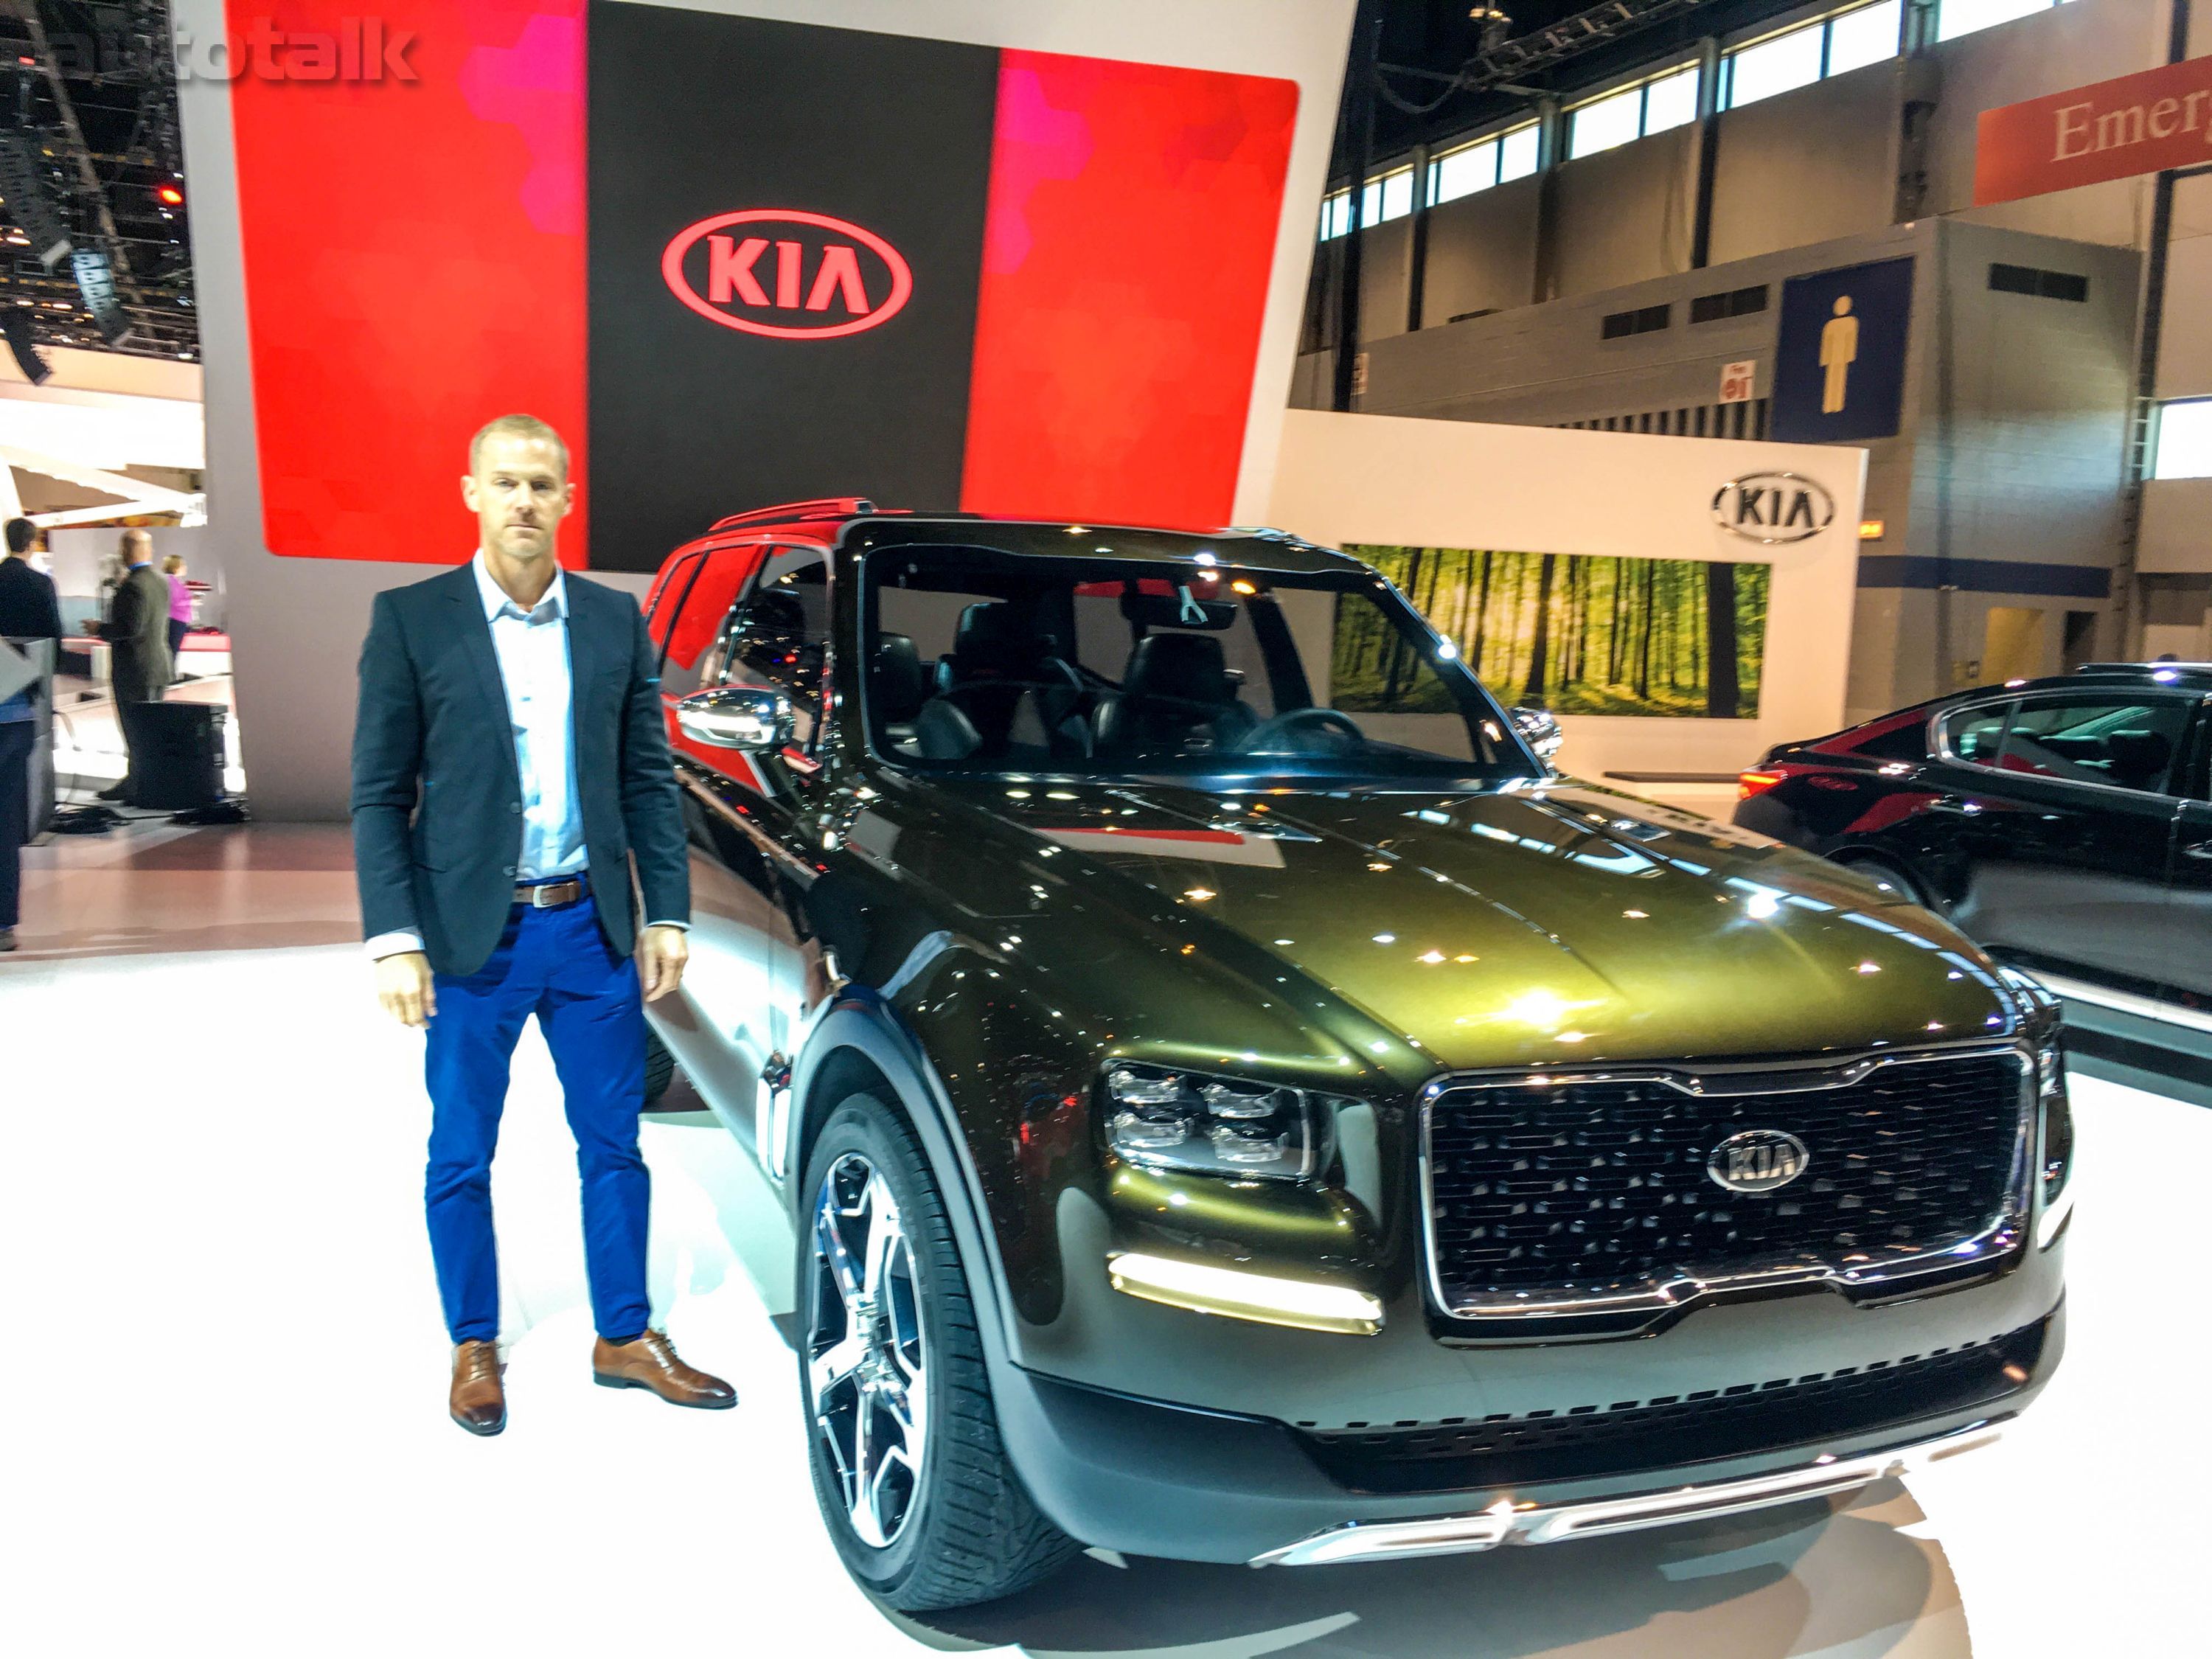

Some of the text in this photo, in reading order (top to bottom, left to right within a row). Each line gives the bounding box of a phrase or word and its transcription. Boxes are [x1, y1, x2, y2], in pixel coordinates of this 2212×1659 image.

[2050, 88, 2212, 163] Emer
[707, 234, 871, 314] KIA
[1737, 486, 1814, 528] KIA
[1727, 1144, 1796, 1181] KIA
